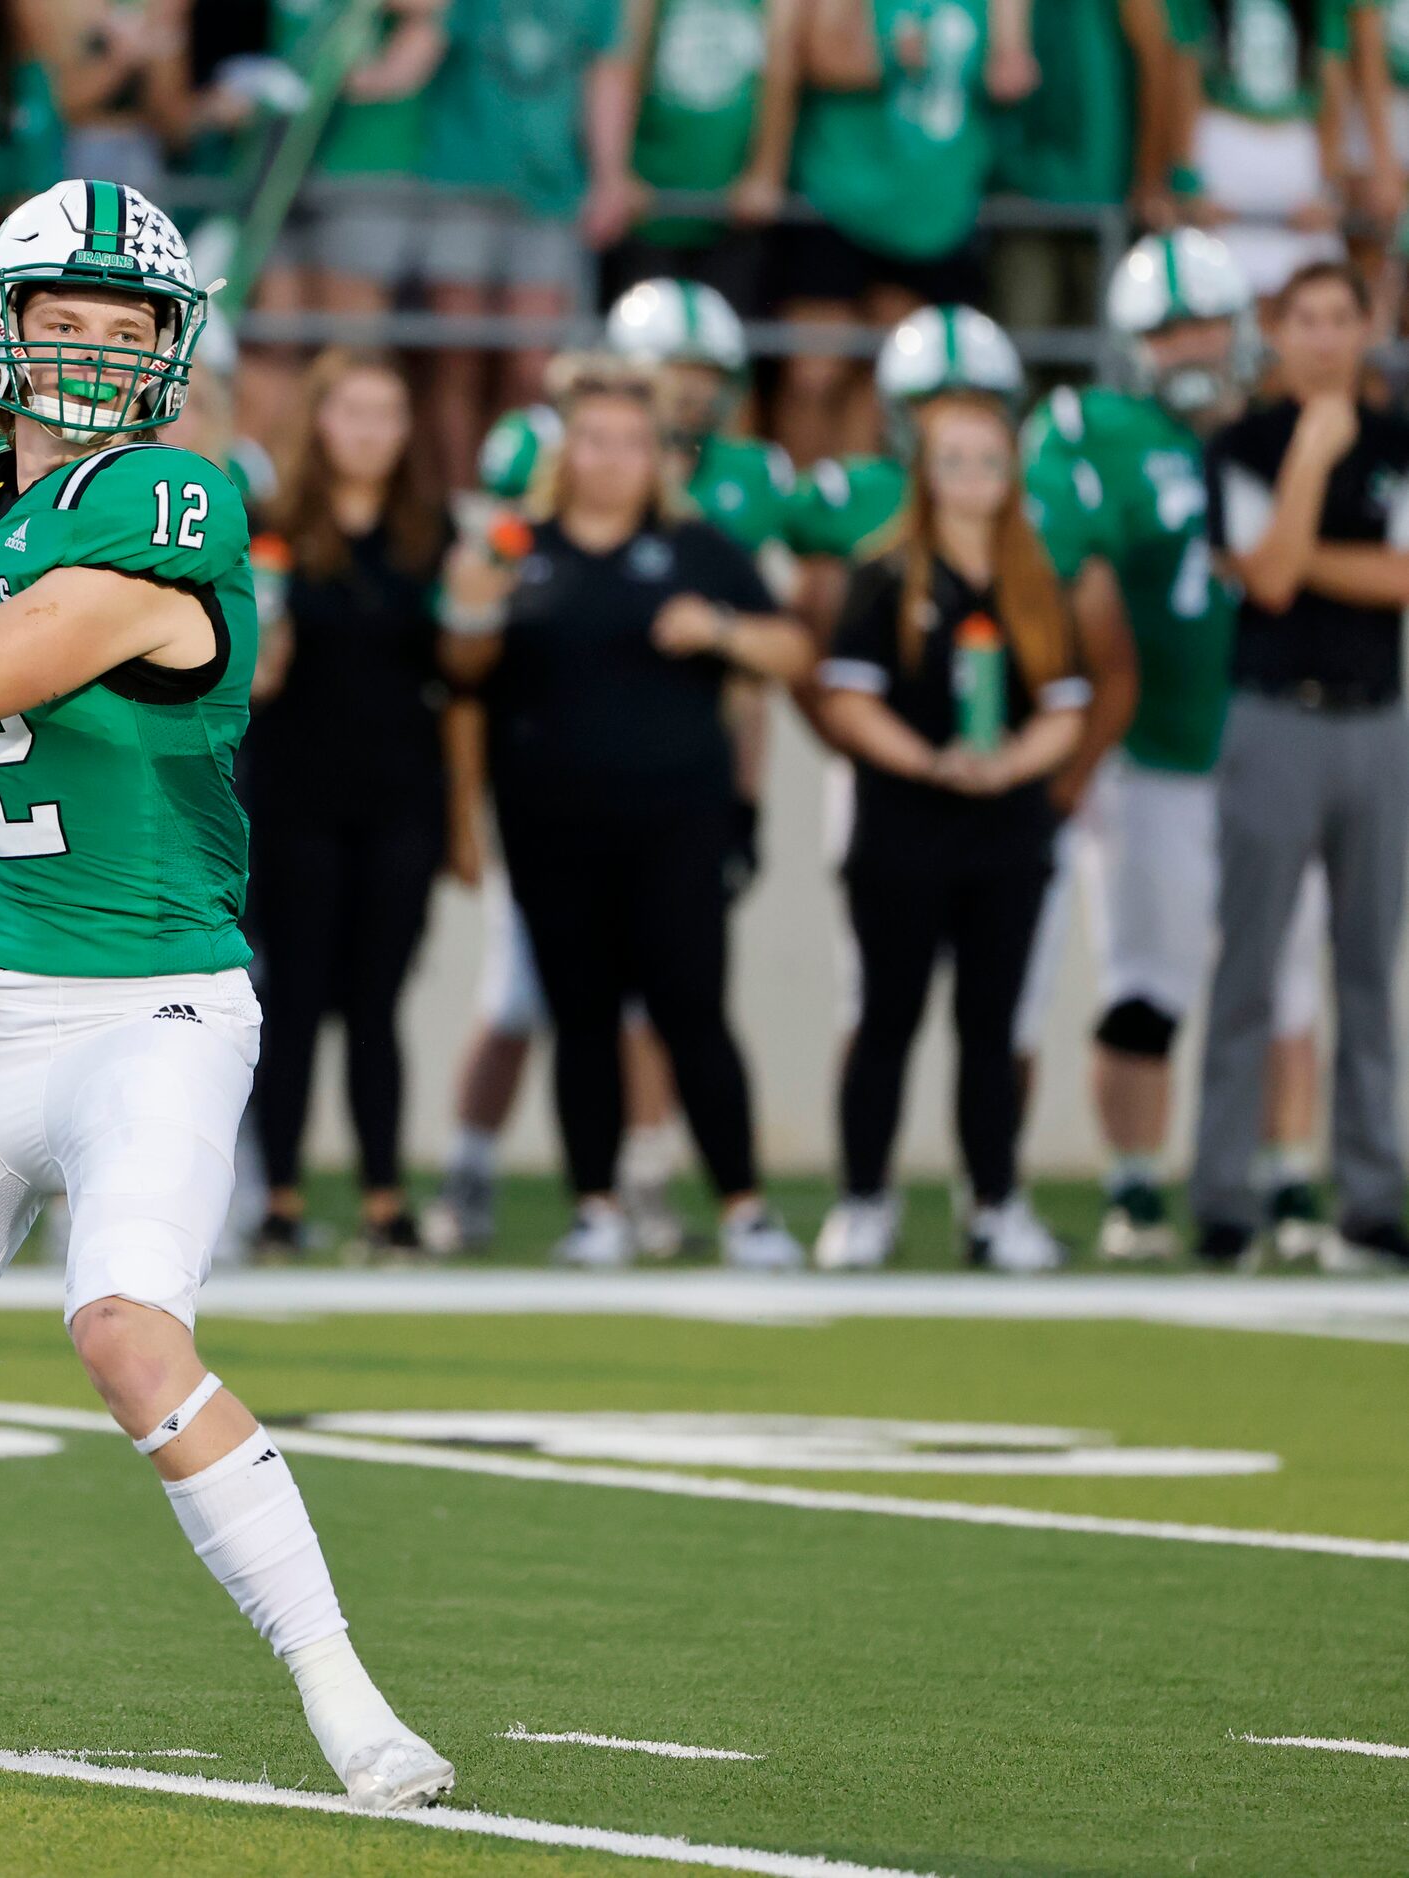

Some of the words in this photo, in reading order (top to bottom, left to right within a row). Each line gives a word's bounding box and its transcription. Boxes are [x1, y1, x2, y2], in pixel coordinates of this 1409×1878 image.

[75, 250, 135, 269] DRAGONS
[150, 479, 210, 551] 12
[4, 536, 27, 552] adidas
